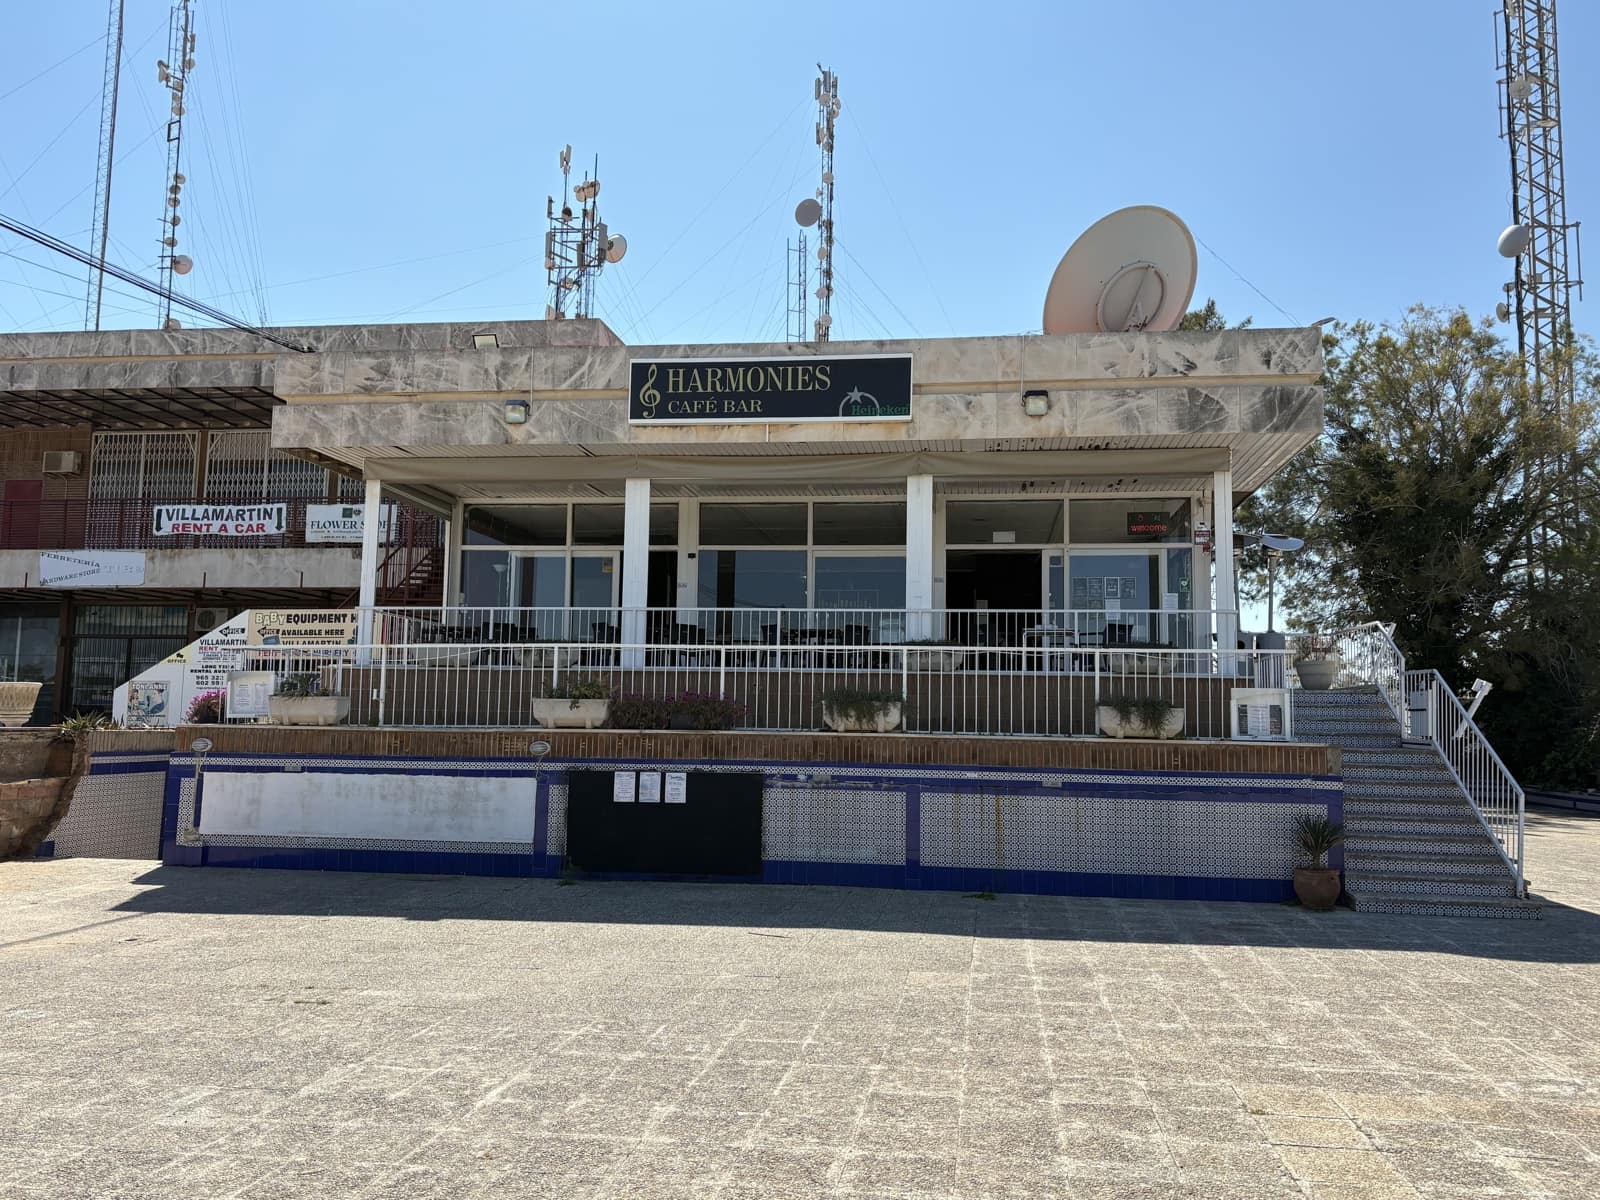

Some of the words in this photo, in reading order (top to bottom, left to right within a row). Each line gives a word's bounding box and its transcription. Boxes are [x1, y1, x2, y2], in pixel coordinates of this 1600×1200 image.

[667, 365, 831, 393] HARMONIES
[667, 396, 718, 414] CAFÉ
[723, 399, 763, 413] BAR
[851, 405, 909, 416] Heineken
[165, 507, 274, 522] VILLAMARTIN
[171, 523, 213, 533] RENT
[218, 523, 228, 533] A
[235, 523, 266, 533] CAR
[310, 520, 358, 529] FLOWER
[360, 520, 388, 529] SP
[1130, 524, 1168, 532] welcome
[255, 612, 285, 626] BABY
[286, 613, 347, 625] EQUIPMENT
